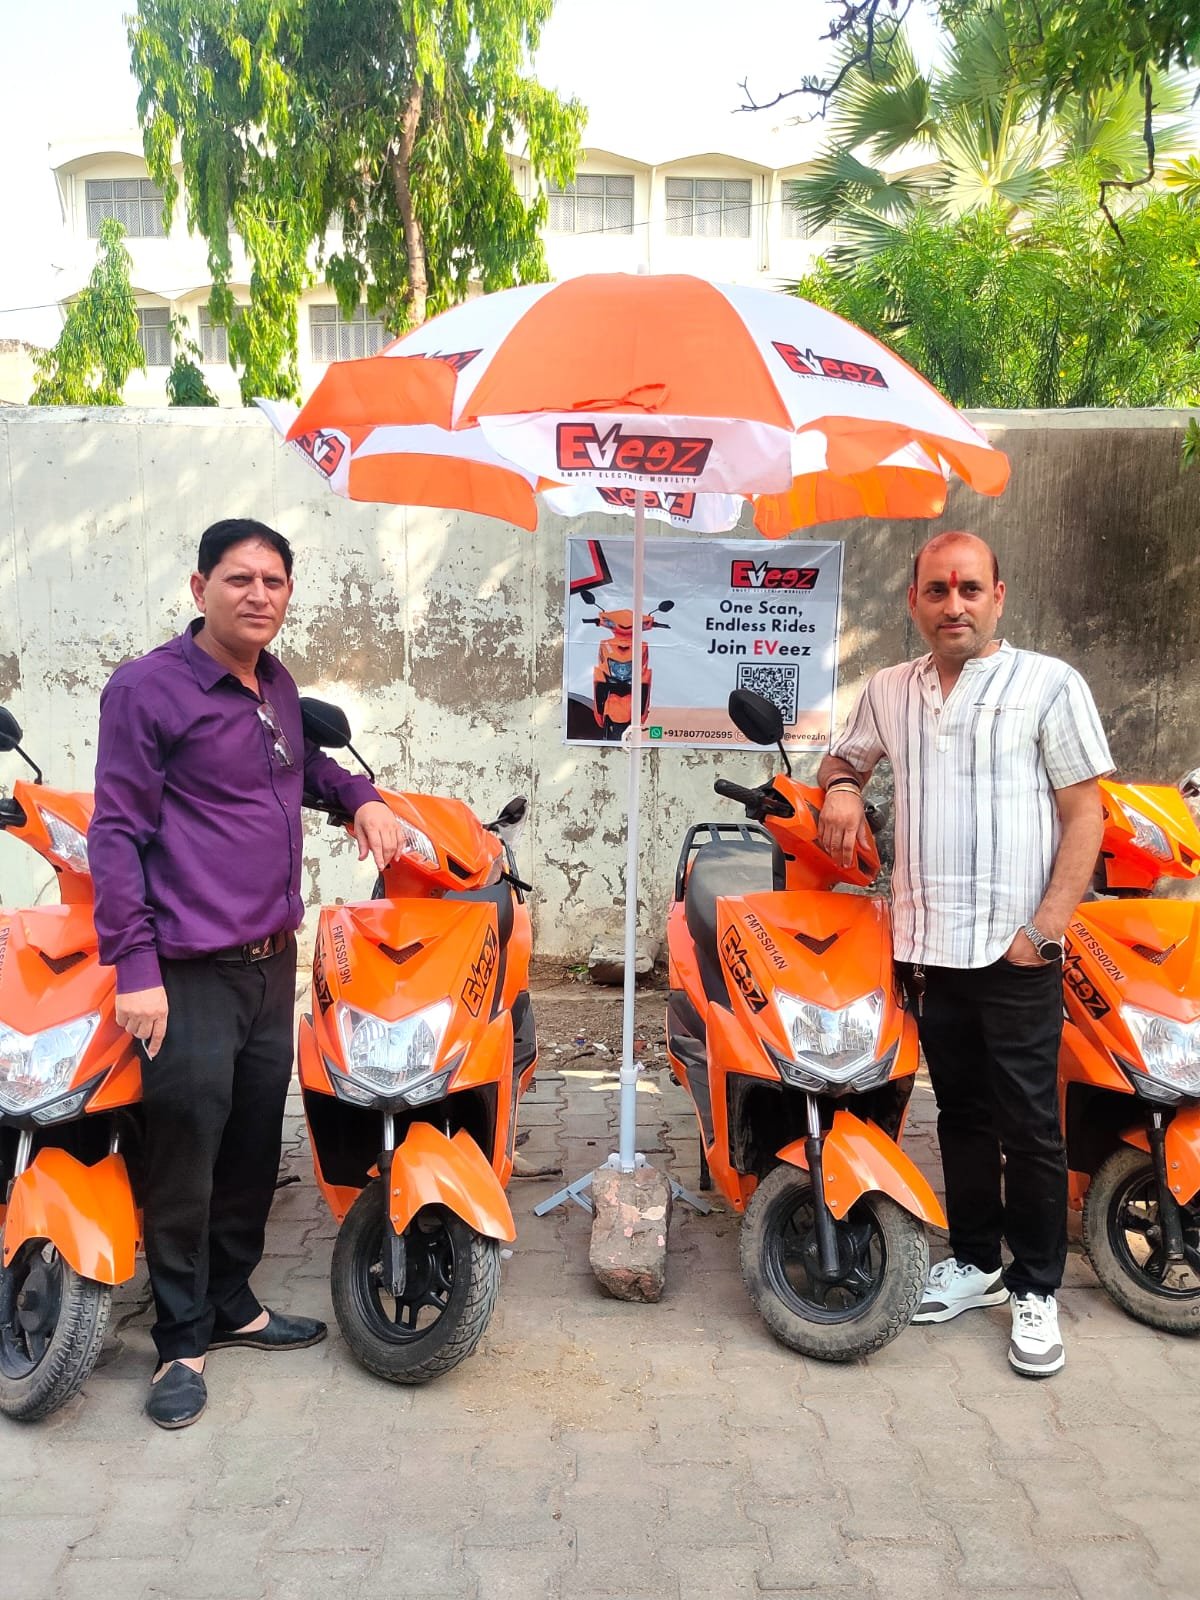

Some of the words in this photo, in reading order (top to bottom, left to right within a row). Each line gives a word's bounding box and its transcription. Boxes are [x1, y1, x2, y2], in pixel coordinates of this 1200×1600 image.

[599, 472, 643, 482] ELECTRIC
[650, 476, 697, 484] MOBILITY
[720, 600, 753, 613] One
[758, 601, 803, 617] Scan,
[706, 617, 766, 631] Endless
[772, 619, 816, 633] Rides
[707, 639, 747, 655] Join
[753, 640, 811, 656] EVeez
[664, 729, 733, 739] +917807702595
[744, 913, 788, 970] FMTSS014N
[333, 925, 353, 985] FMTSS019N
[1072, 922, 1124, 981] FMTSS002N
